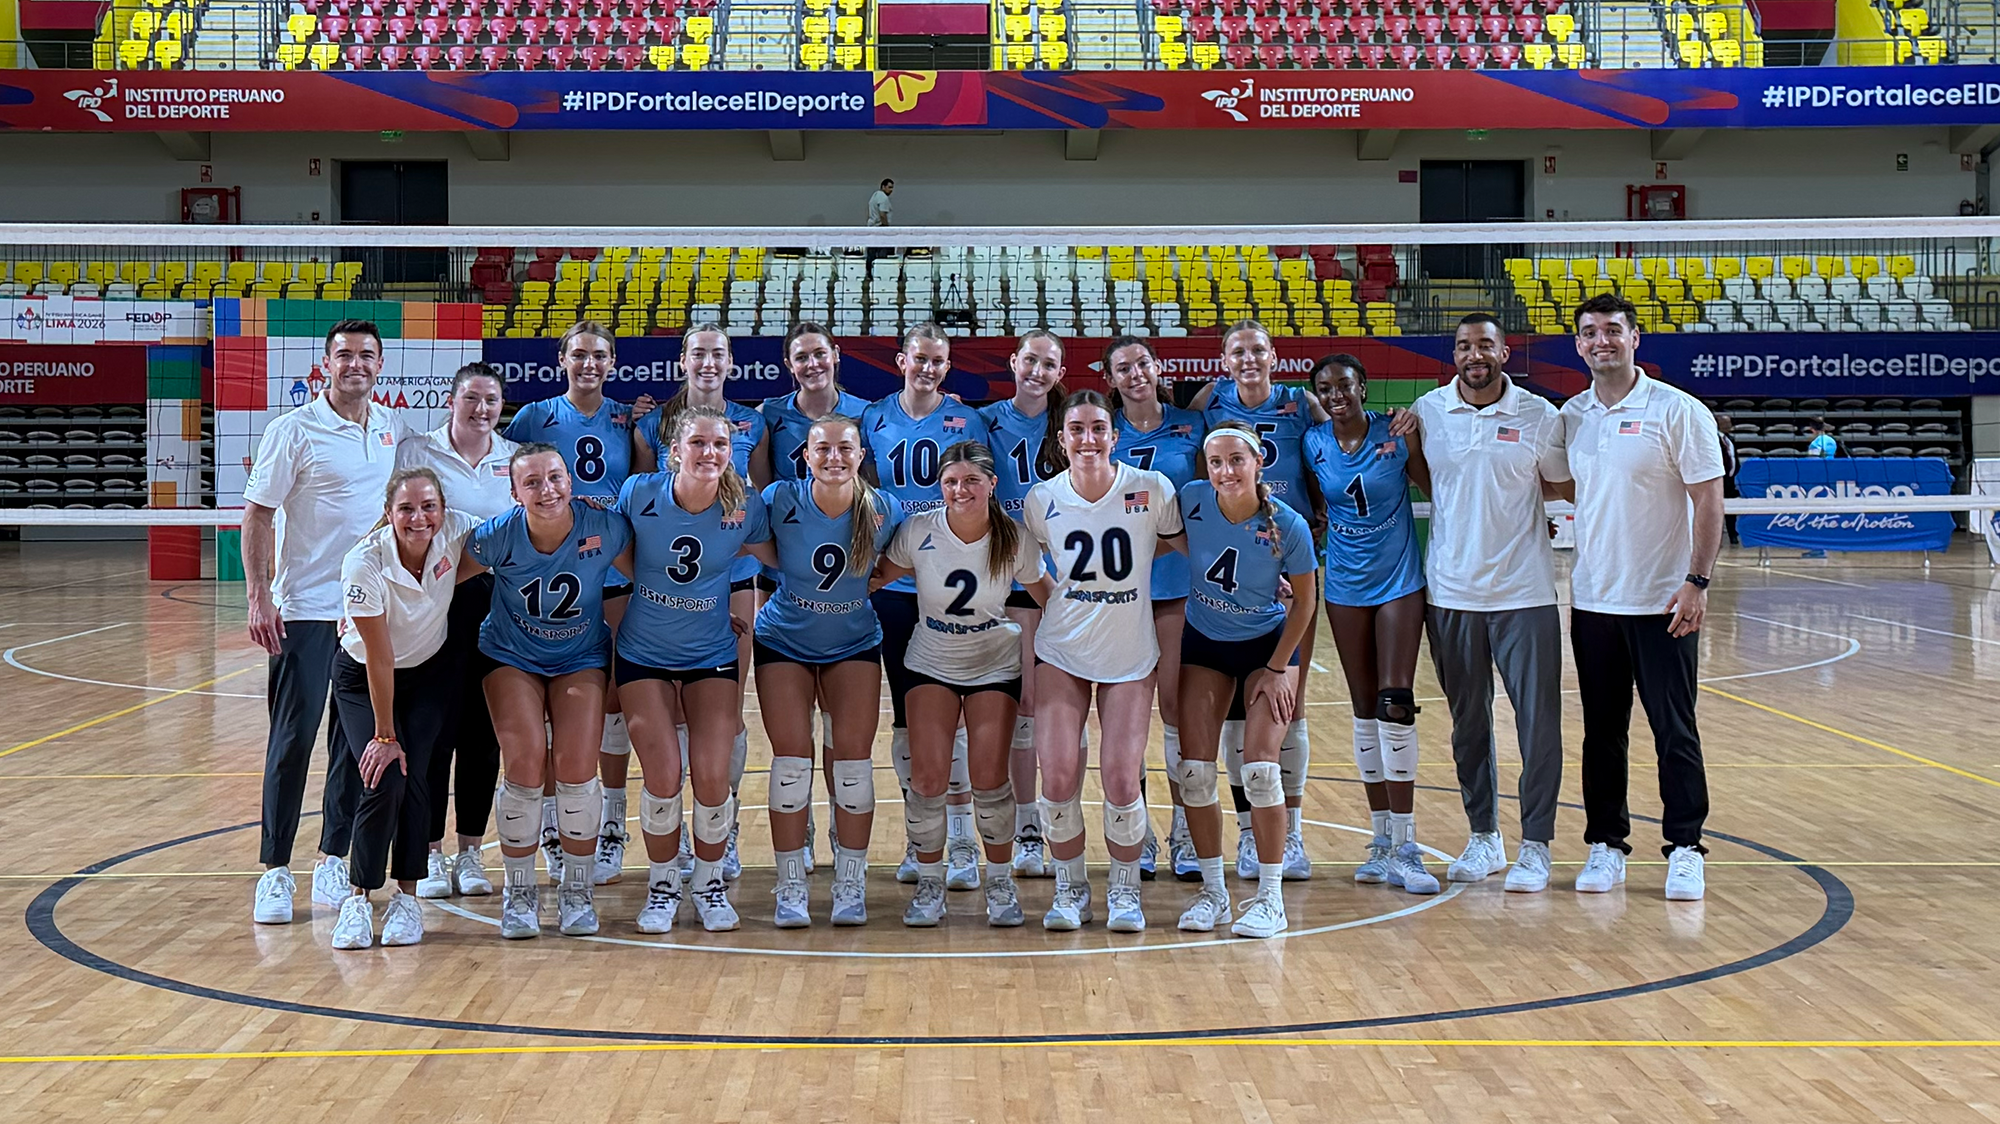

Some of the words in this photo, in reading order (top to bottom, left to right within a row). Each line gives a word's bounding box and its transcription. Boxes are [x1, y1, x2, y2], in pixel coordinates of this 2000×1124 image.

[78, 96, 102, 108] IPD
[125, 88, 206, 103] INSTITUTO
[209, 88, 285, 103] PERUANO
[562, 90, 866, 117] #IPDFortaleceElDeporte
[1214, 96, 1238, 108] IPD
[1259, 88, 1339, 102] INSTITUTO
[1341, 87, 1414, 102] PERUANO
[125, 105, 155, 118] DEL
[158, 105, 230, 119] DEPORTE
[1260, 104, 1289, 118] DEL
[1291, 104, 1361, 118] DEPORTE
[45, 319, 76, 329] LIMA
[77, 319, 106, 329] 2026
[13, 362, 95, 377] PERUANO
[412, 389, 453, 409] 202
[574, 434, 607, 484] 8
[887, 437, 941, 488] 10
[1128, 445, 1157, 471] 7
[1343, 472, 1370, 518] 1
[1125, 505, 1149, 515] USA
[665, 534, 703, 586] 3
[811, 542, 847, 592] 9
[1064, 526, 1133, 582] 20
[1203, 545, 1239, 594] 4
[518, 571, 583, 619] 12
[943, 568, 977, 617] 2
